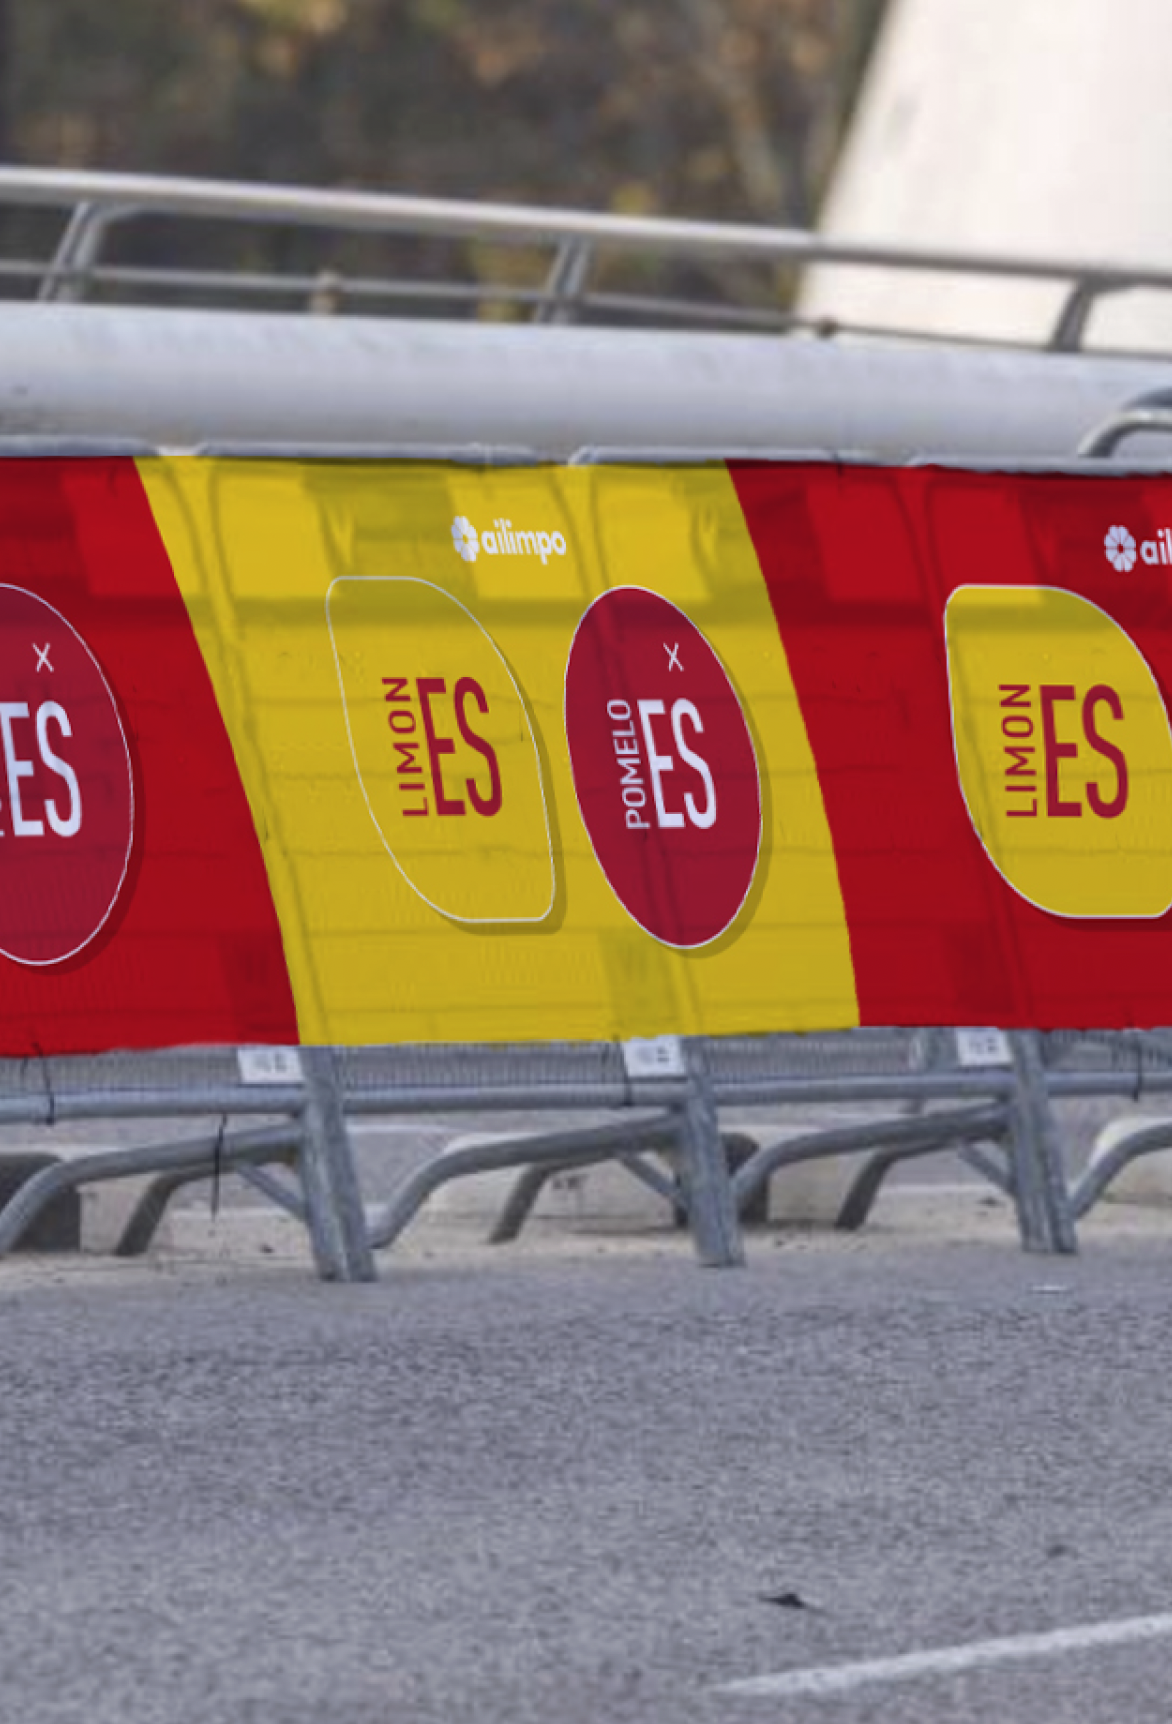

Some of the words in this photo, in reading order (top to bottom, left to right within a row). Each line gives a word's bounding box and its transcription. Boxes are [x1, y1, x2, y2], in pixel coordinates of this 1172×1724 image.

[482, 518, 567, 566] ailimpo
[0, 701, 82, 838] ES
[381, 677, 429, 817] LIMON
[415, 676, 502, 817] ES
[606, 699, 650, 830] POMELO
[637, 698, 717, 829] ES
[998, 684, 1038, 818] LIMON
[1039, 684, 1129, 819] ES
